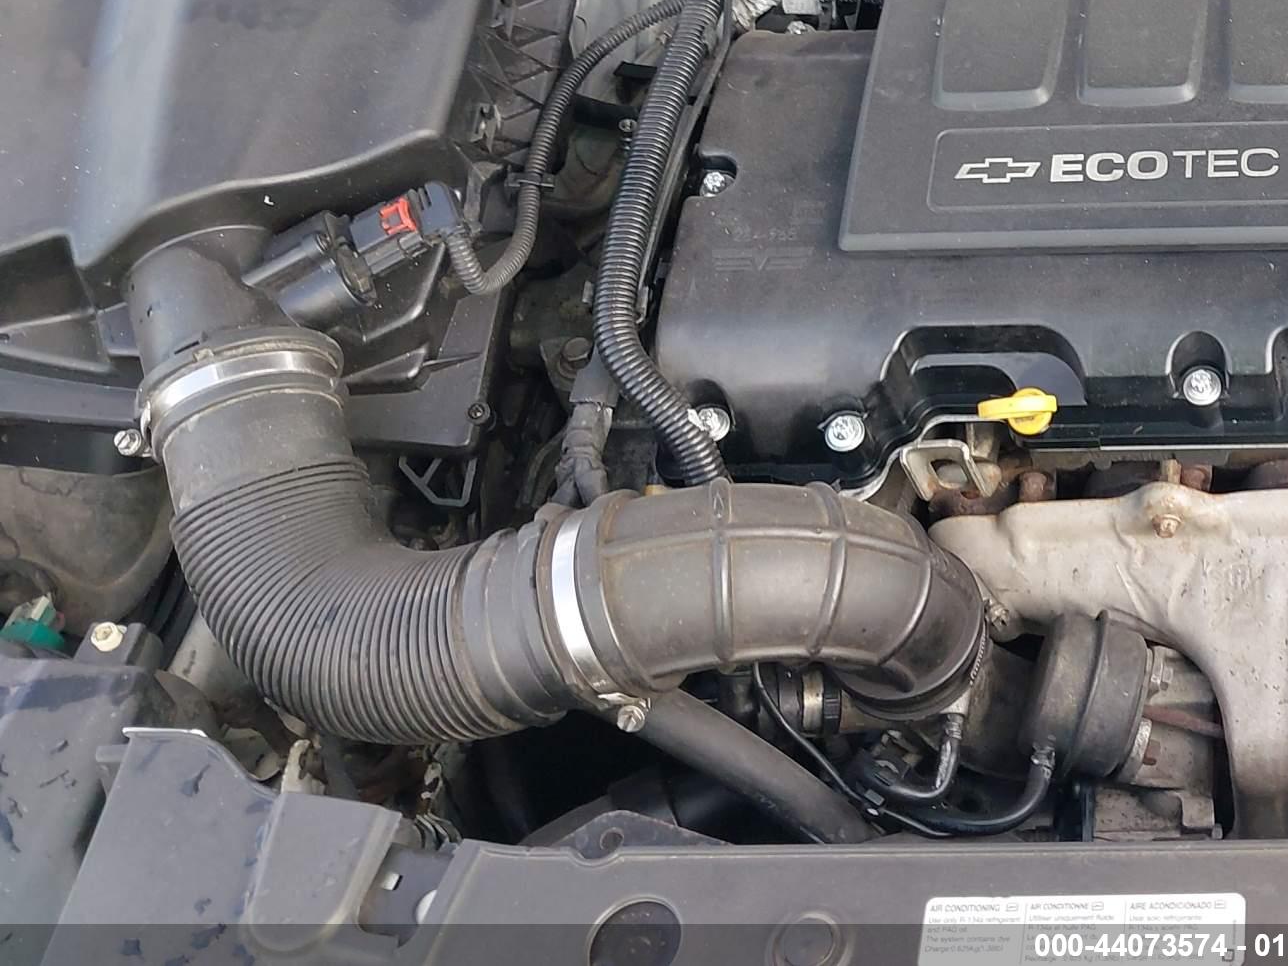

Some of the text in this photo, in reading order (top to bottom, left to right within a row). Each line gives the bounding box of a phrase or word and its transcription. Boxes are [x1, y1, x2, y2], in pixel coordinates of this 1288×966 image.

[1049, 148, 1280, 183] ECOTEC
[930, 904, 1001, 913] AIR CONDITIONING
